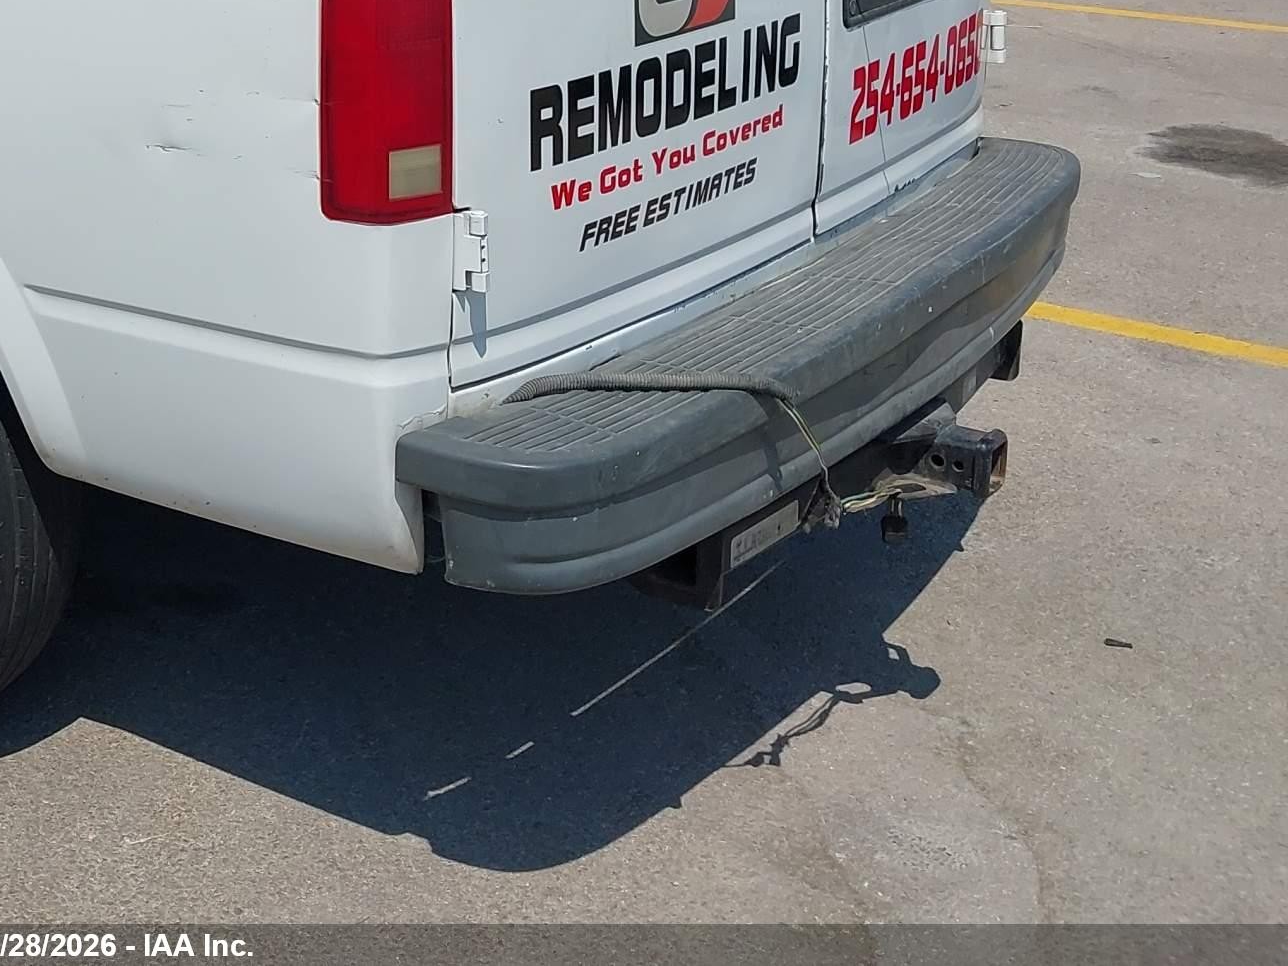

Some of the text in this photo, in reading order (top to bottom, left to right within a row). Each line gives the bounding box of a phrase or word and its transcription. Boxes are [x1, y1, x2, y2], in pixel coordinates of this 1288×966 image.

[529, 12, 802, 172] REMODELING
[550, 103, 784, 211] We Got You Covered
[578, 156, 758, 253] FREE ESTIMATES
